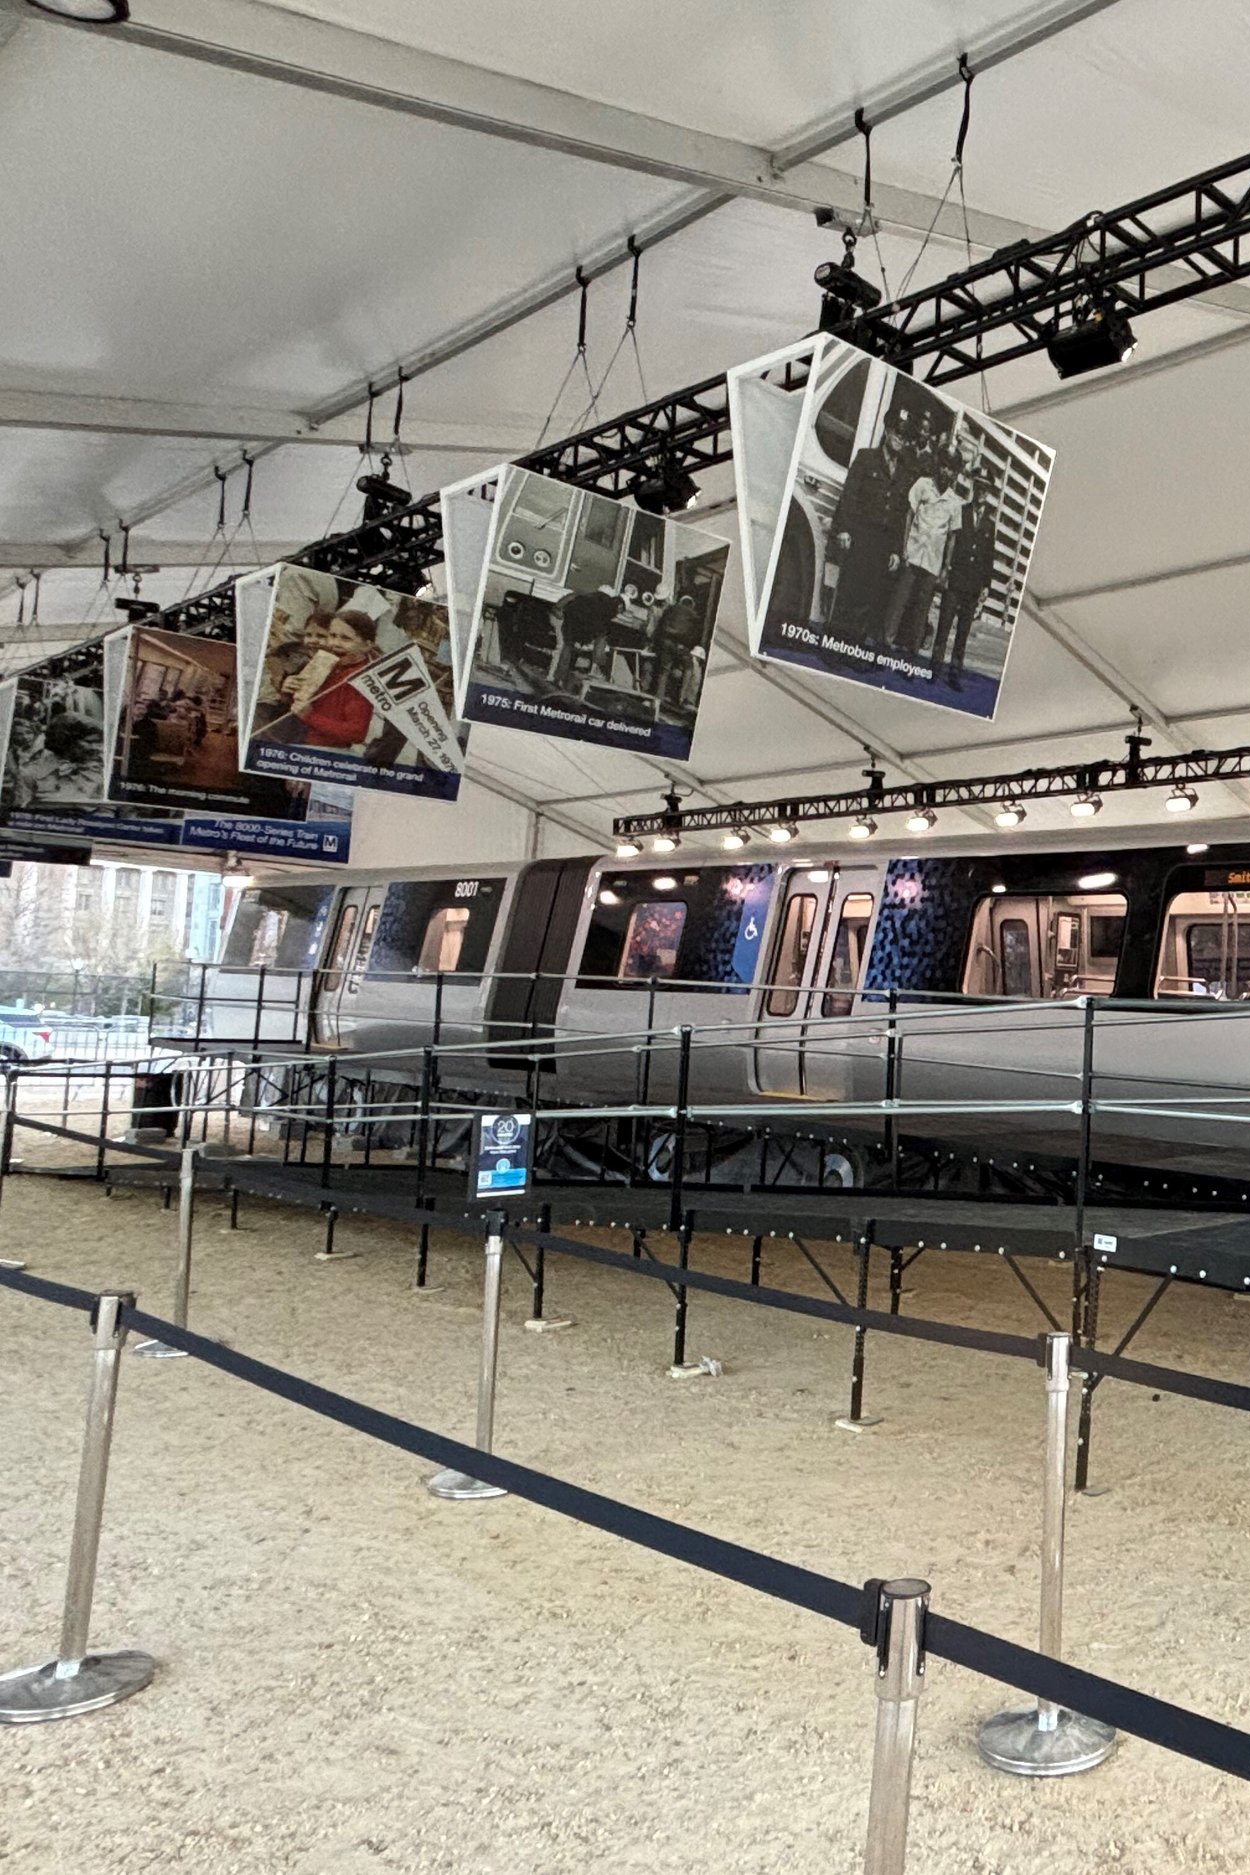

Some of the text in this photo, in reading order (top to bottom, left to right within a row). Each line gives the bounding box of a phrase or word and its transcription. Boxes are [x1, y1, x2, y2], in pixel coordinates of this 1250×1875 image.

[780, 622, 933, 680] 1970s: Metrobus employees
[361, 674, 392, 712] metro
[377, 657, 427, 701] M
[406, 706, 430, 739] March
[418, 701, 449, 743] Opening
[481, 693, 652, 737] 1975: First Metrorail car delivered
[256, 759, 357, 782] opening of Metrorail
[289, 752, 332, 768] Children
[333, 760, 378, 775] celebrate
[379, 767, 395, 778] the
[396, 770, 424, 782] grand
[454, 880, 480, 898] 8001
[497, 1120, 515, 1134] 20
